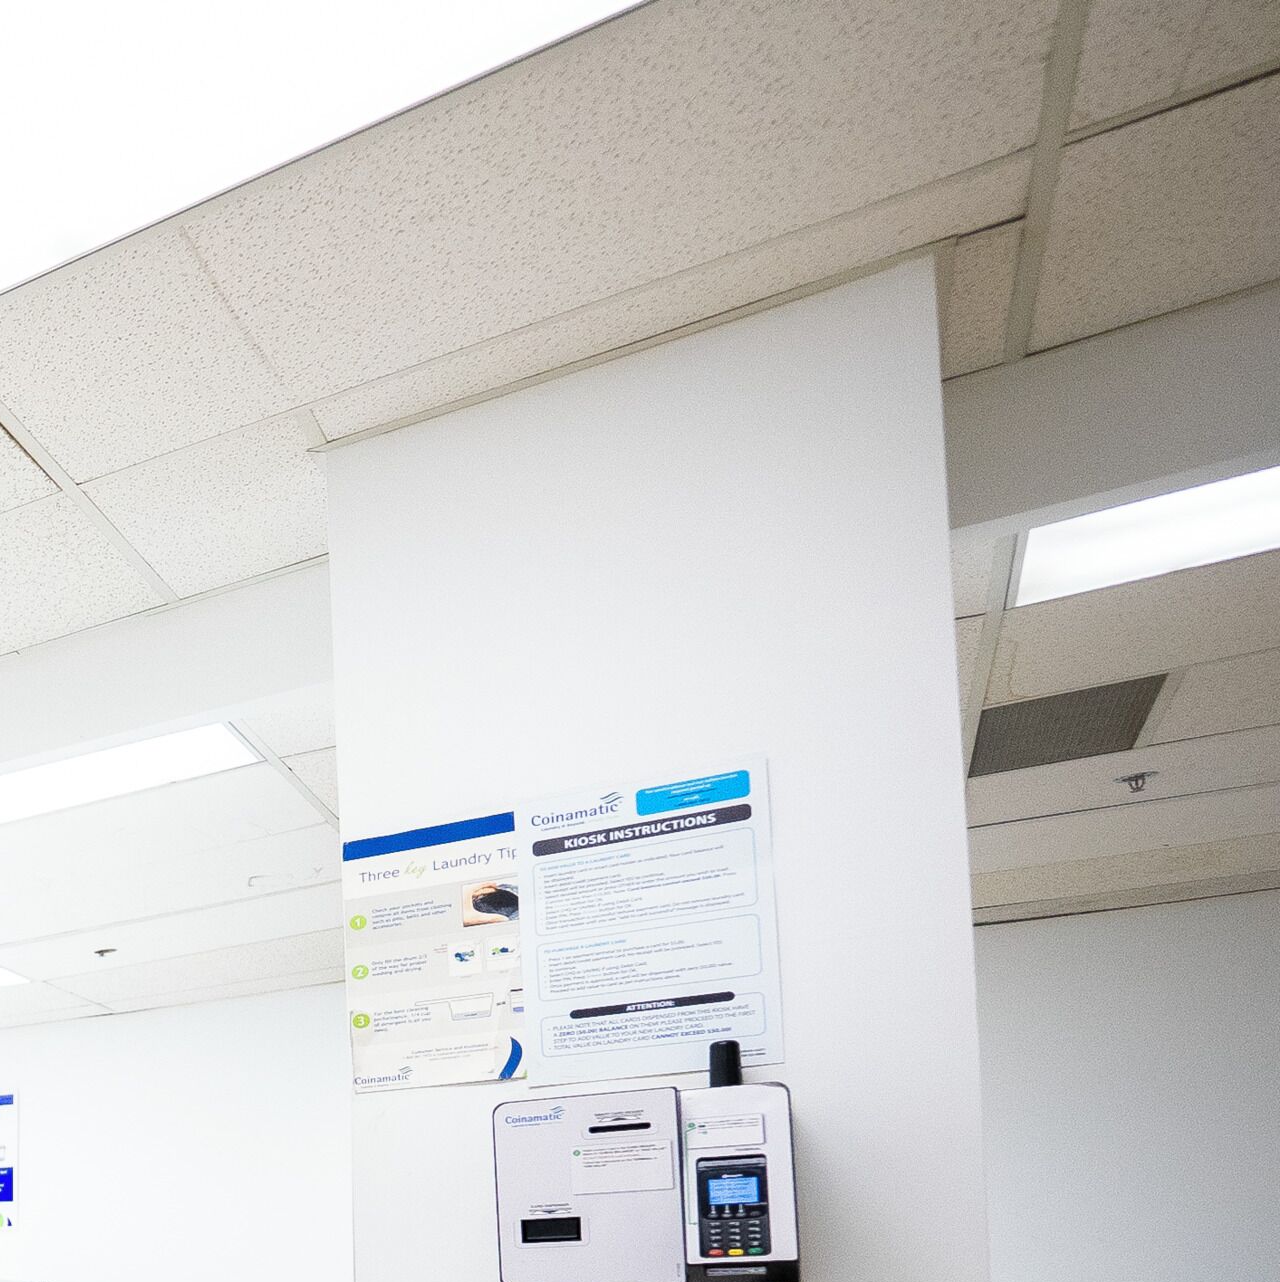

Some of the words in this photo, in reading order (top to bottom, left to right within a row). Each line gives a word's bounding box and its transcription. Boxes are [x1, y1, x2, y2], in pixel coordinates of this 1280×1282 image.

[532, 803, 618, 826] Coinamatic
[564, 830, 606, 849] KIOSK
[609, 813, 716, 842] INSTRUCTIONS
[360, 866, 399, 883] Three
[433, 850, 491, 872] Laundry
[505, 1113, 562, 1124] Coinamatic
